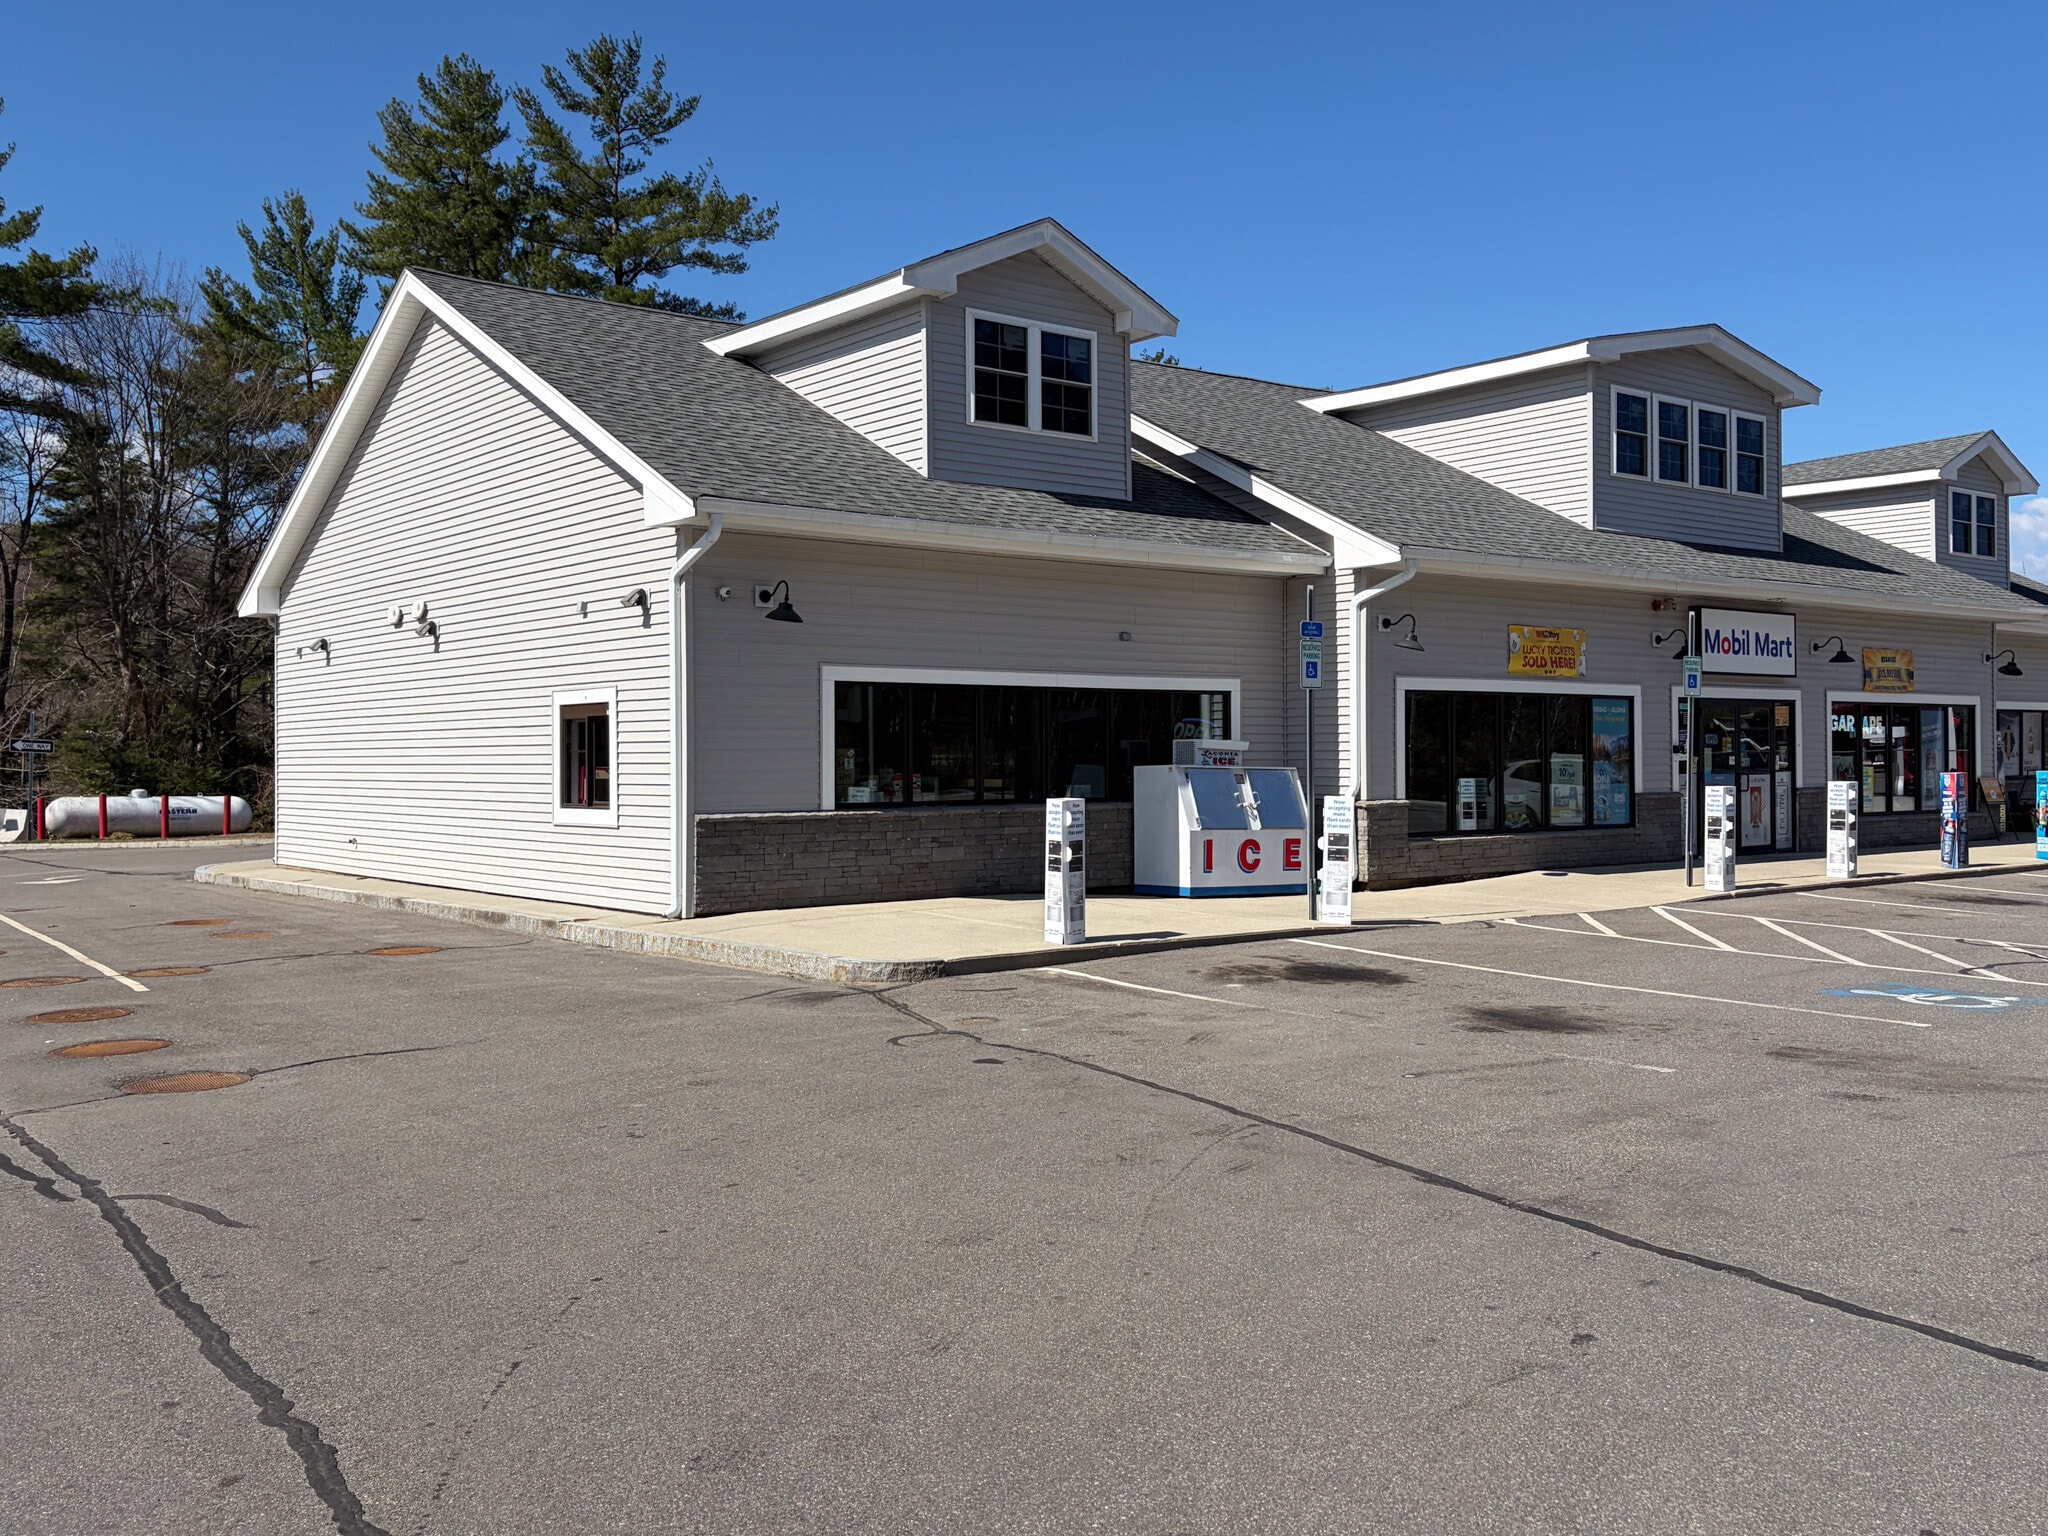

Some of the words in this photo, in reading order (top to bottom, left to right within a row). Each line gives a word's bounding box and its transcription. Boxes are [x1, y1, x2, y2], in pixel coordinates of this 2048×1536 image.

[1704, 629, 1750, 655] Mobil
[1755, 632, 1793, 658] Mart
[1303, 652, 1321, 660] PARKING
[1522, 645, 1546, 655] LUCKY
[1547, 646, 1576, 656] TICKETS
[1522, 656, 1548, 668] SOLD
[1550, 657, 1576, 669] HERE!
[1201, 749, 1239, 759] LACONIA
[1212, 757, 1236, 766] ICE
[1203, 838, 1301, 873] ICE
